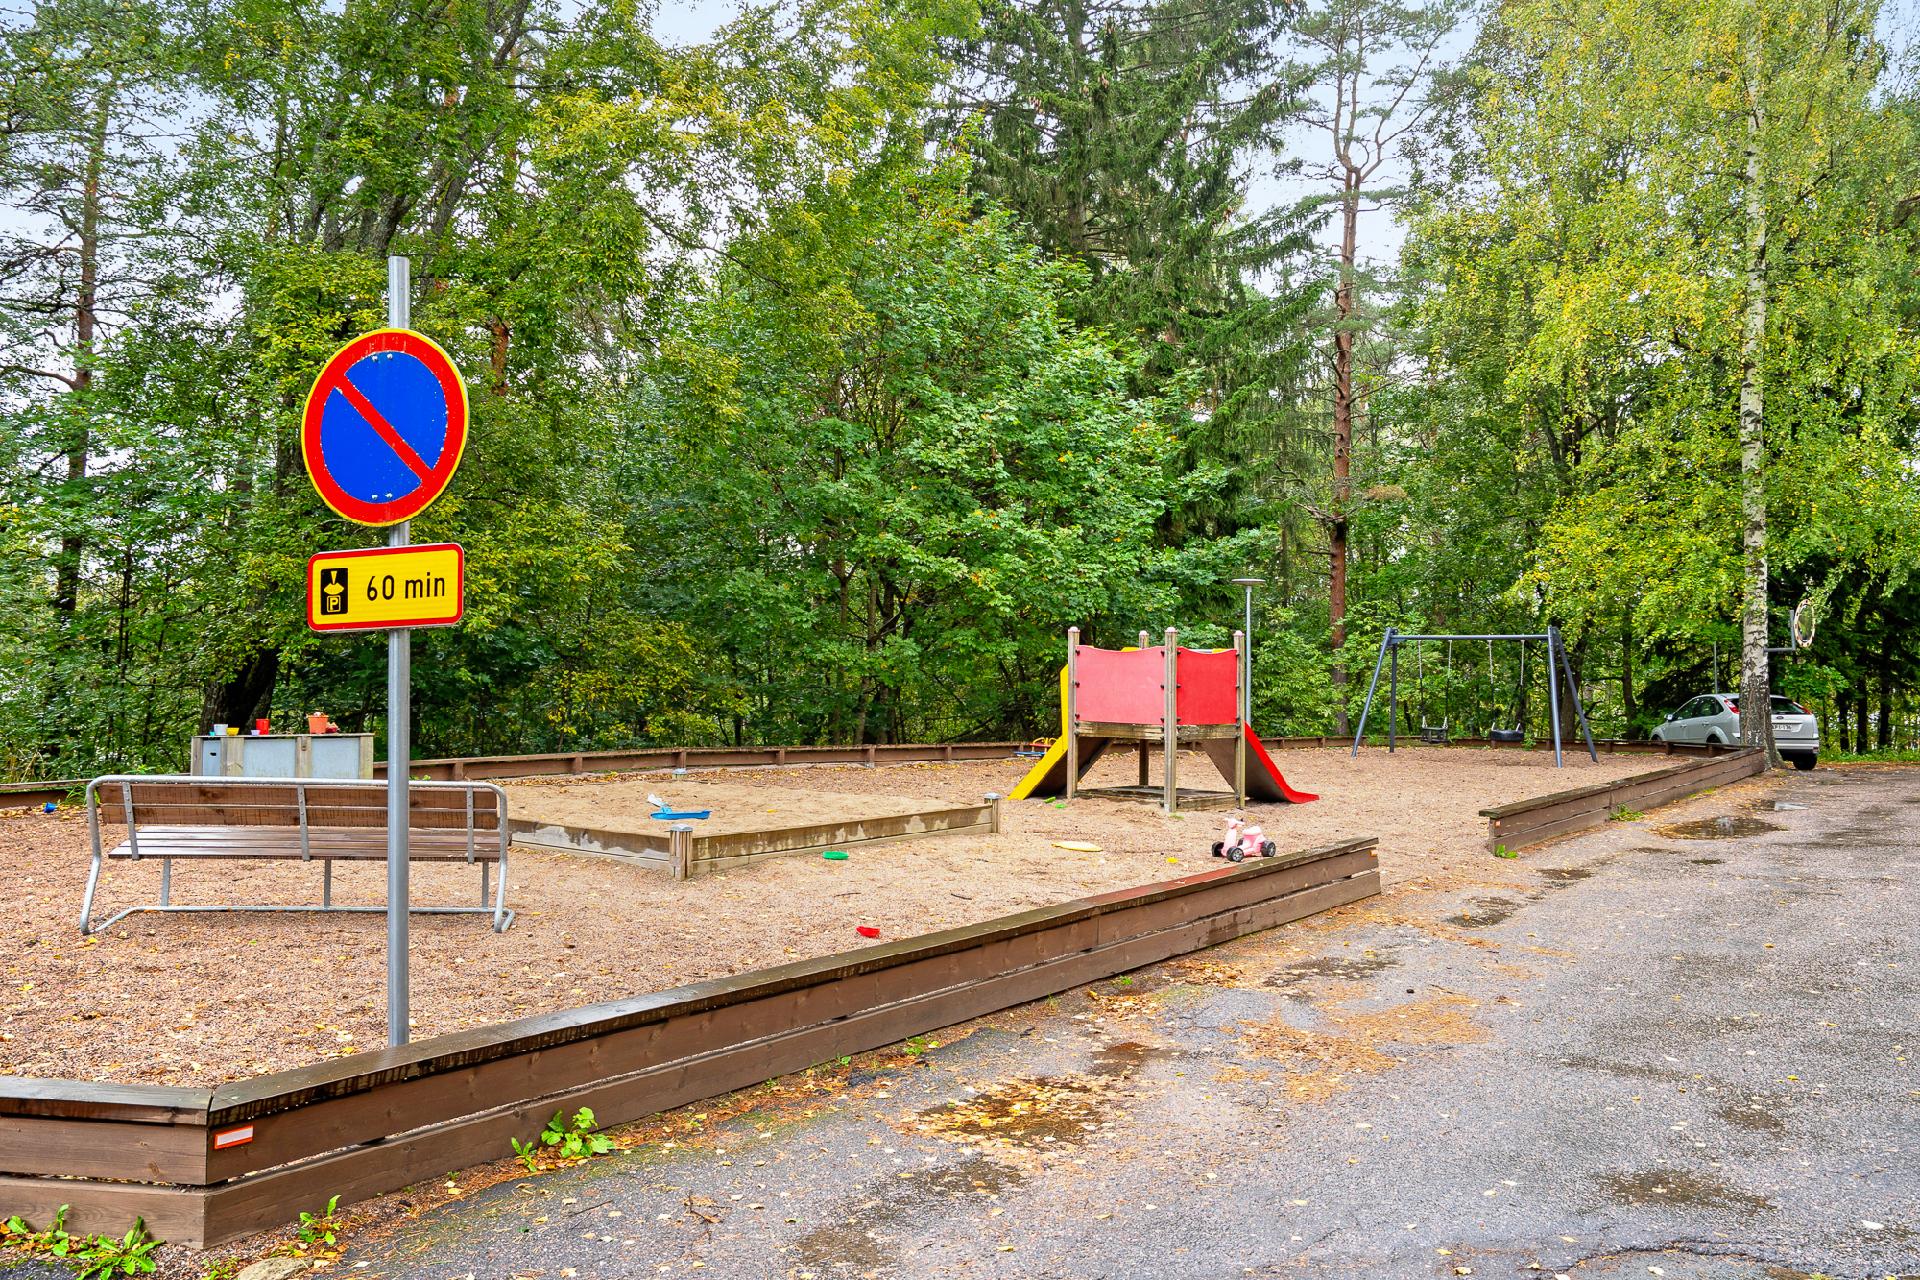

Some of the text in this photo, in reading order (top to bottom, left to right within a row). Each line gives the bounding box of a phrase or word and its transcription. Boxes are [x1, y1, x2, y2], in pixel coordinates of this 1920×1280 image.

[367, 572, 445, 601] 60 min
[329, 597, 339, 611] P
